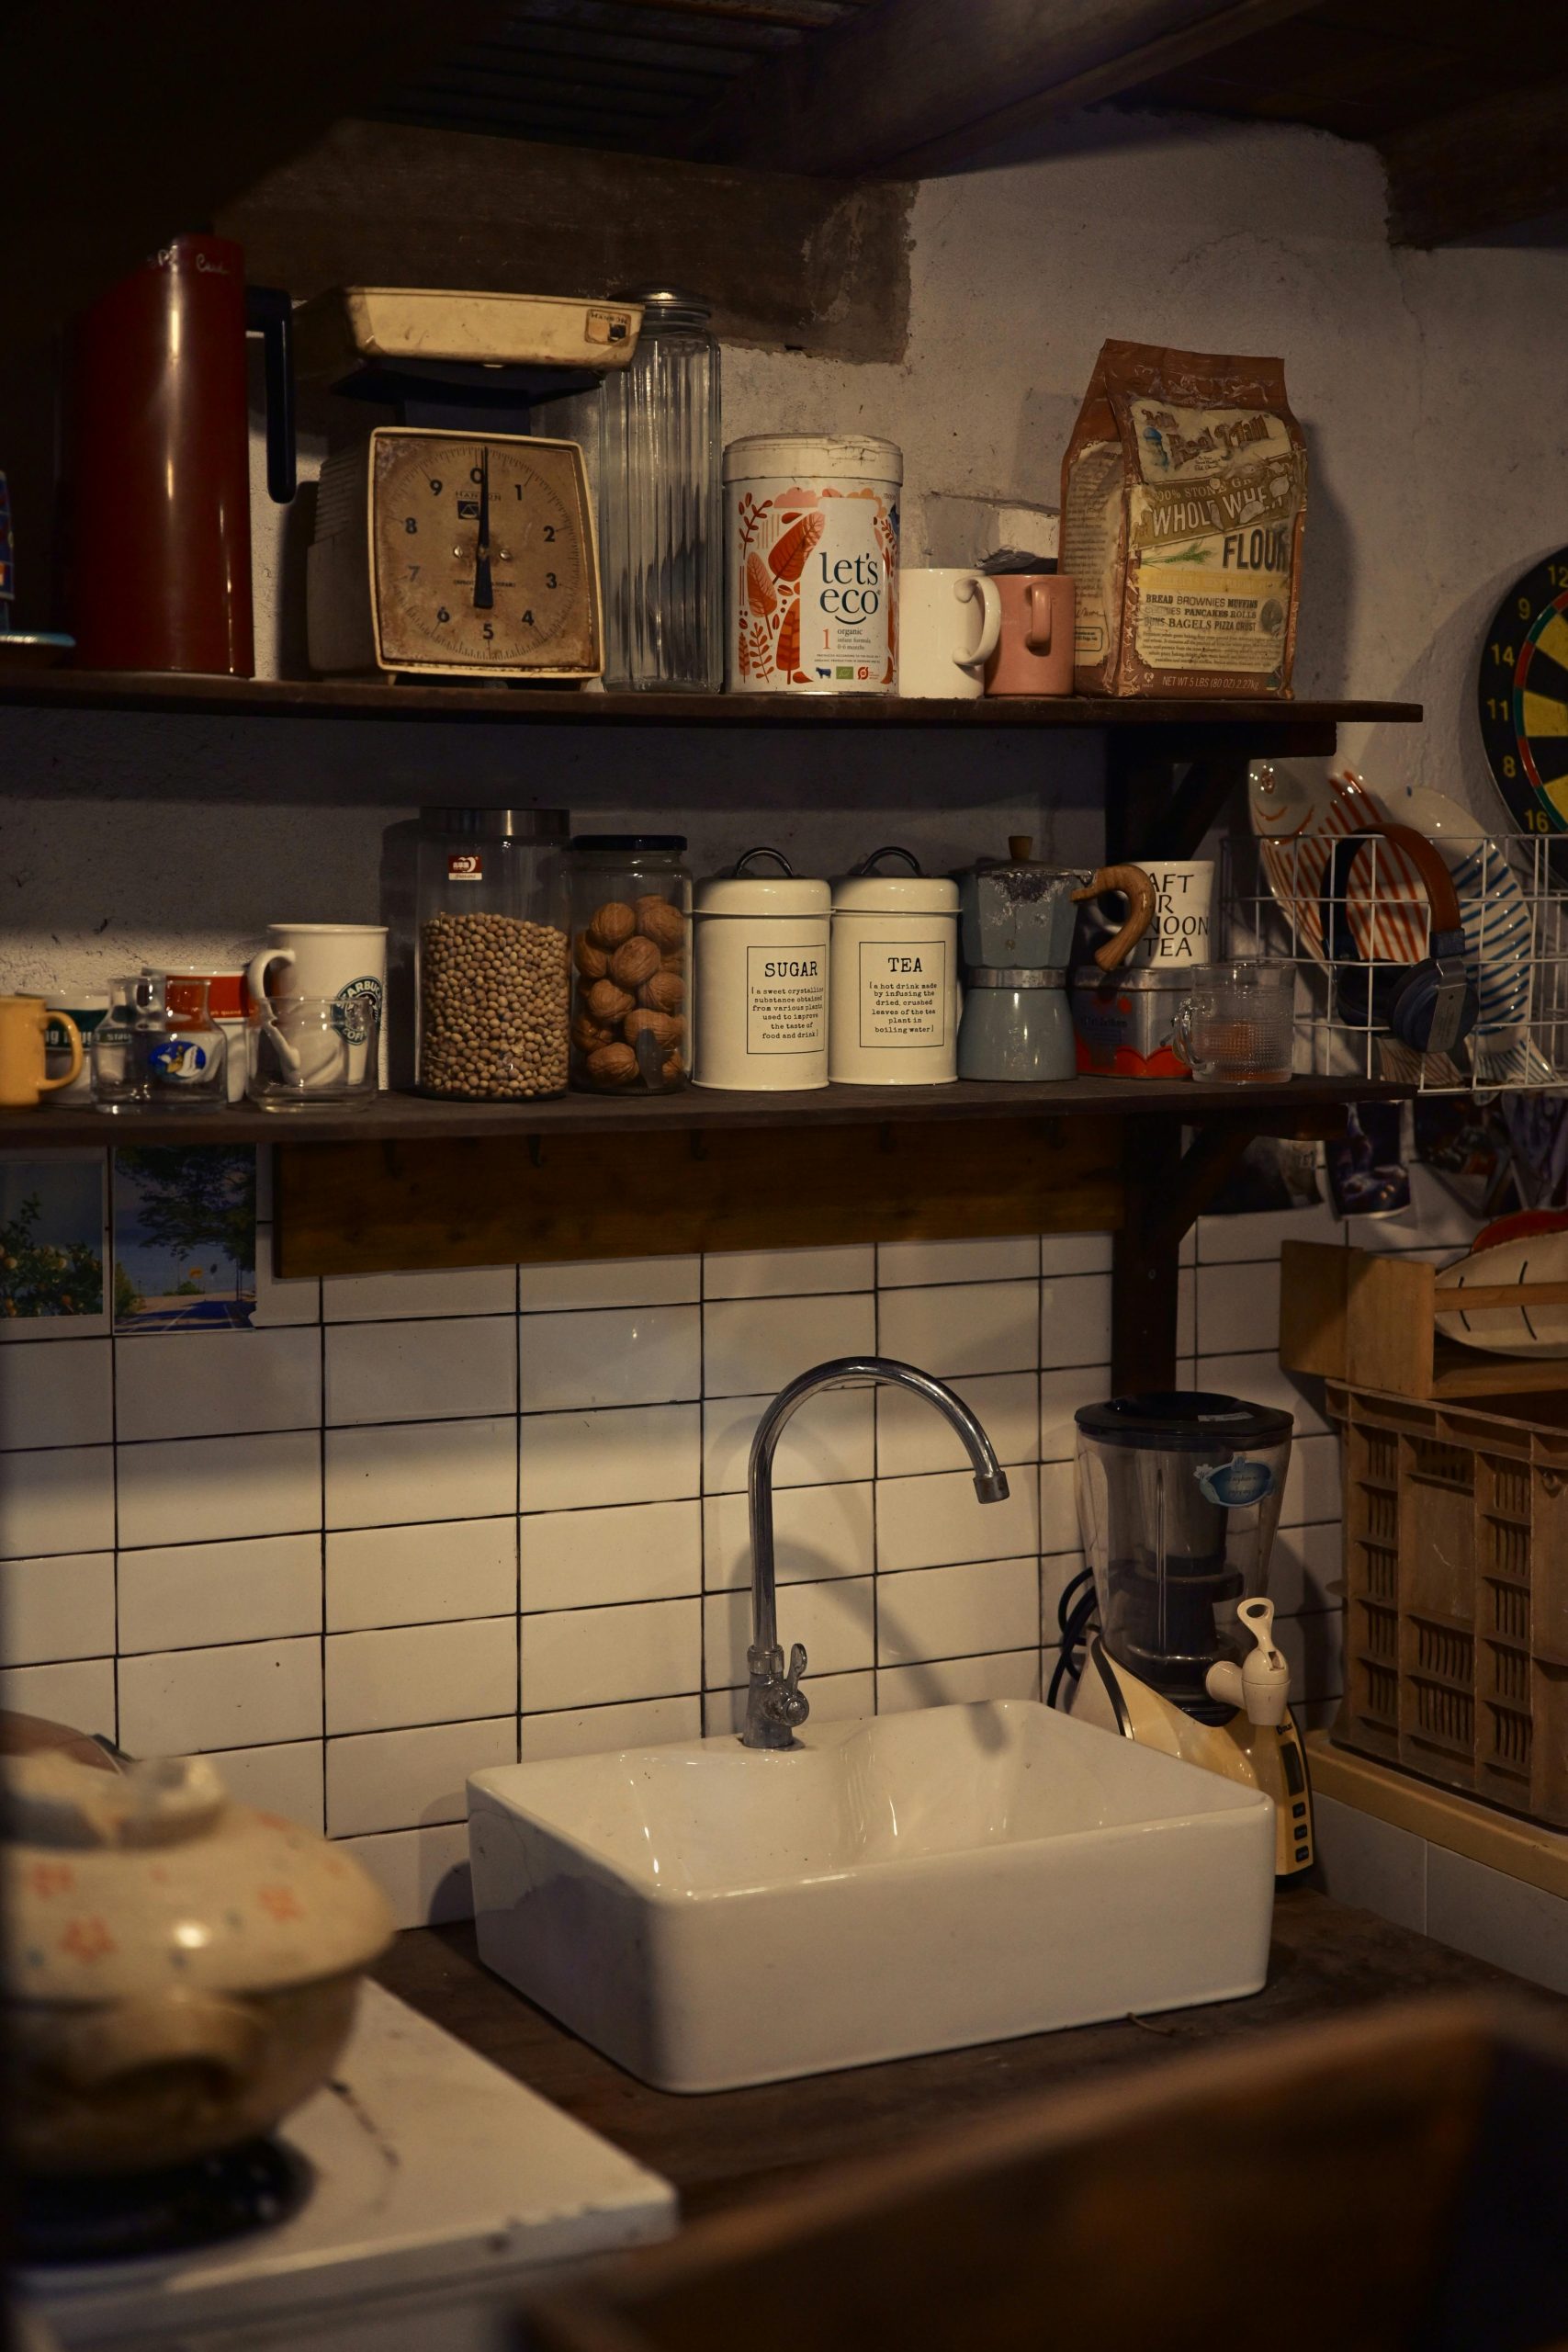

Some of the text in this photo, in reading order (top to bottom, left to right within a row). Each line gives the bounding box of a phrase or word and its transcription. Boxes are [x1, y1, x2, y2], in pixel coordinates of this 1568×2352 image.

[470, 468, 483, 484] 0
[430, 480, 442, 496] 9
[456, 491, 502, 502] HANON
[514, 485, 523, 501] 1
[1222, 486, 1283, 519] WHE
[405, 517, 417, 534] 8
[544, 526, 555, 542] 2
[408, 565, 421, 582] 7
[819, 552, 878, 585] let's
[1548, 565, 1568, 588] 12
[546, 572, 557, 589] 3
[820, 589, 878, 615] eco
[1146, 594, 1258, 608] BREAD BROWNIES MUFFINS
[1518, 598, 1530, 620] 9
[437, 606, 450, 623] 6
[522, 610, 535, 626] 4
[1184, 608, 1228, 617] PANCAKES
[1231, 609, 1256, 618] ROLLS
[483, 623, 493, 639] 5
[1168, 618, 1211, 629] BAGELS
[1214, 621, 1234, 630] PIZZA
[1236, 622, 1256, 631] CRUST
[823, 628, 830, 649] 1
[1491, 644, 1514, 667] 14
[1163, 676, 1176, 686] NET
[1178, 676, 1188, 686] WT
[1190, 677, 1194, 686] 5
[1196, 677, 1209, 687] LBS
[1487, 698, 1509, 721] 11
[1503, 755, 1516, 778] 8
[1525, 809, 1549, 833] 16
[1143, 937, 1192, 956] TEA
[764, 961, 818, 977] SUGAR
[887, 957, 922, 972] TEA
